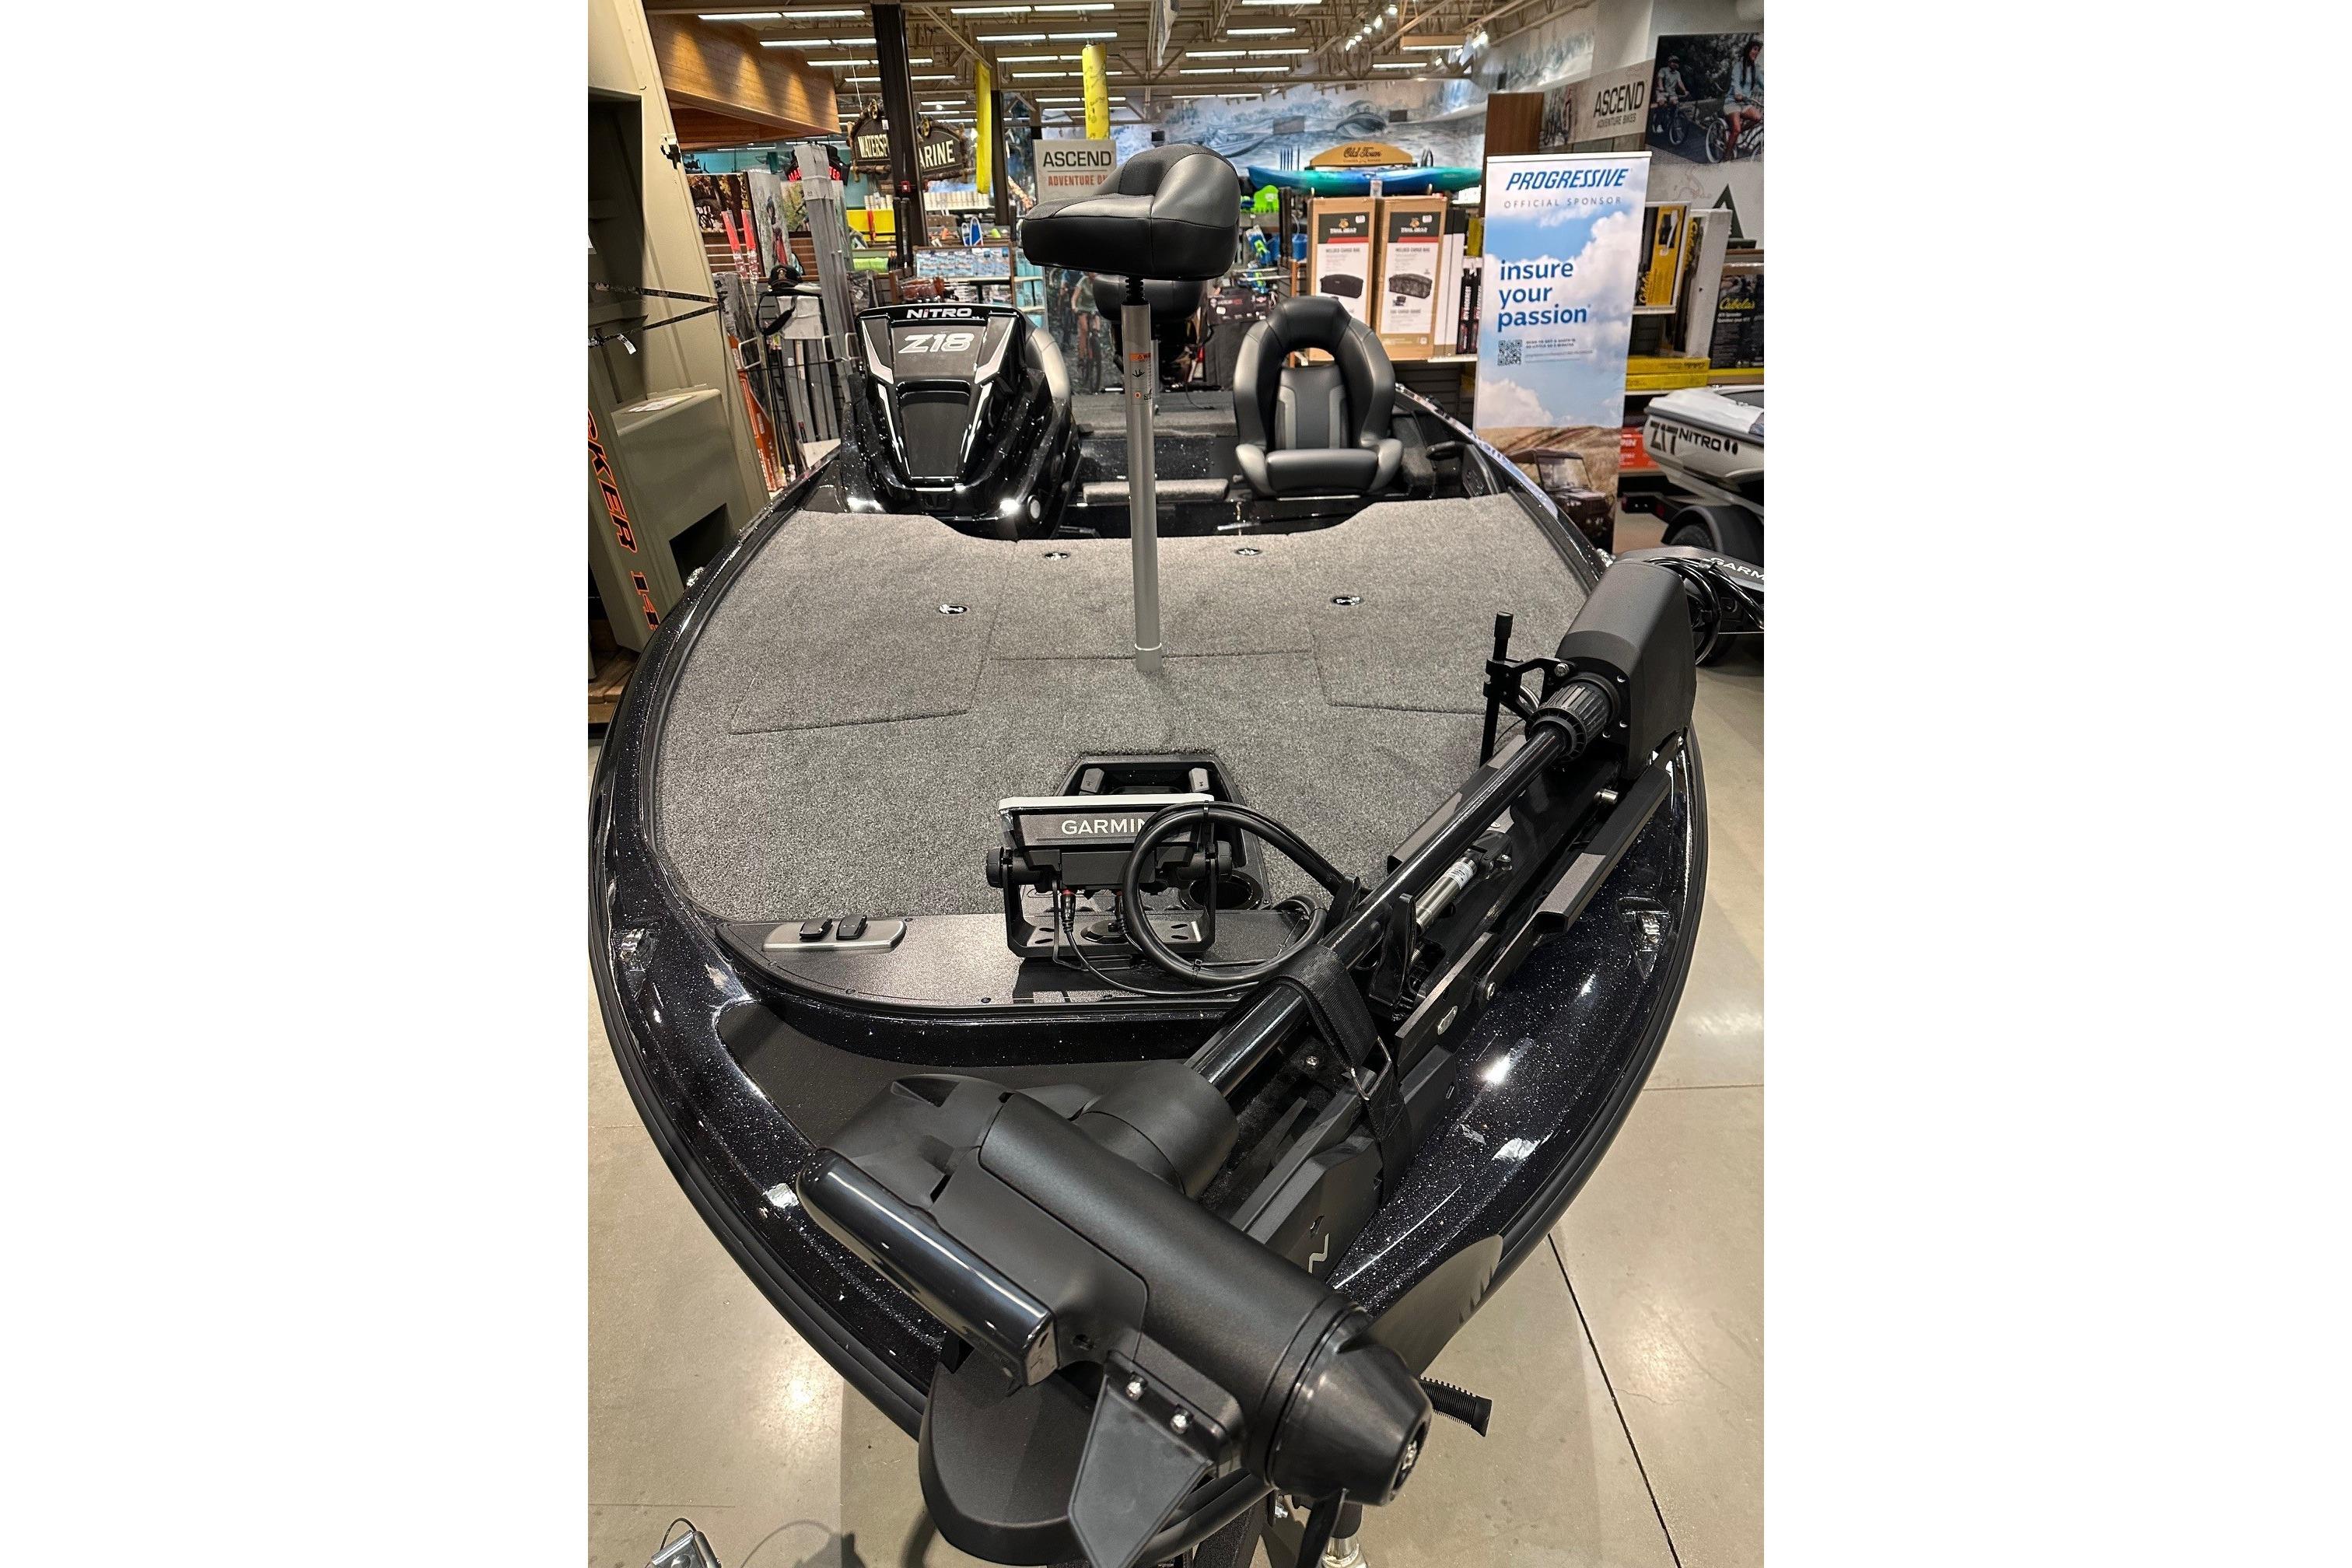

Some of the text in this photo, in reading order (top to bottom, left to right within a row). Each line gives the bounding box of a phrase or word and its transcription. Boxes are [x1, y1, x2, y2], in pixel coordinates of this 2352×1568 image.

[1593, 81, 1645, 117] ASCEND
[1043, 151, 1111, 167] ASCEND
[1343, 146, 1381, 158] Old Town
[1048, 175, 1094, 187] ADVENTURE
[1506, 168, 1629, 191] PROGRESSIVE
[1503, 196, 1622, 208] OFFICIAL SPONSOR
[1500, 259, 1574, 281] insure
[1499, 286, 1553, 310] your
[906, 308, 972, 319] NITRO
[1498, 303, 1587, 333] passion
[898, 333, 975, 354] Z18
[1650, 420, 1722, 455] Z17 NITRO
